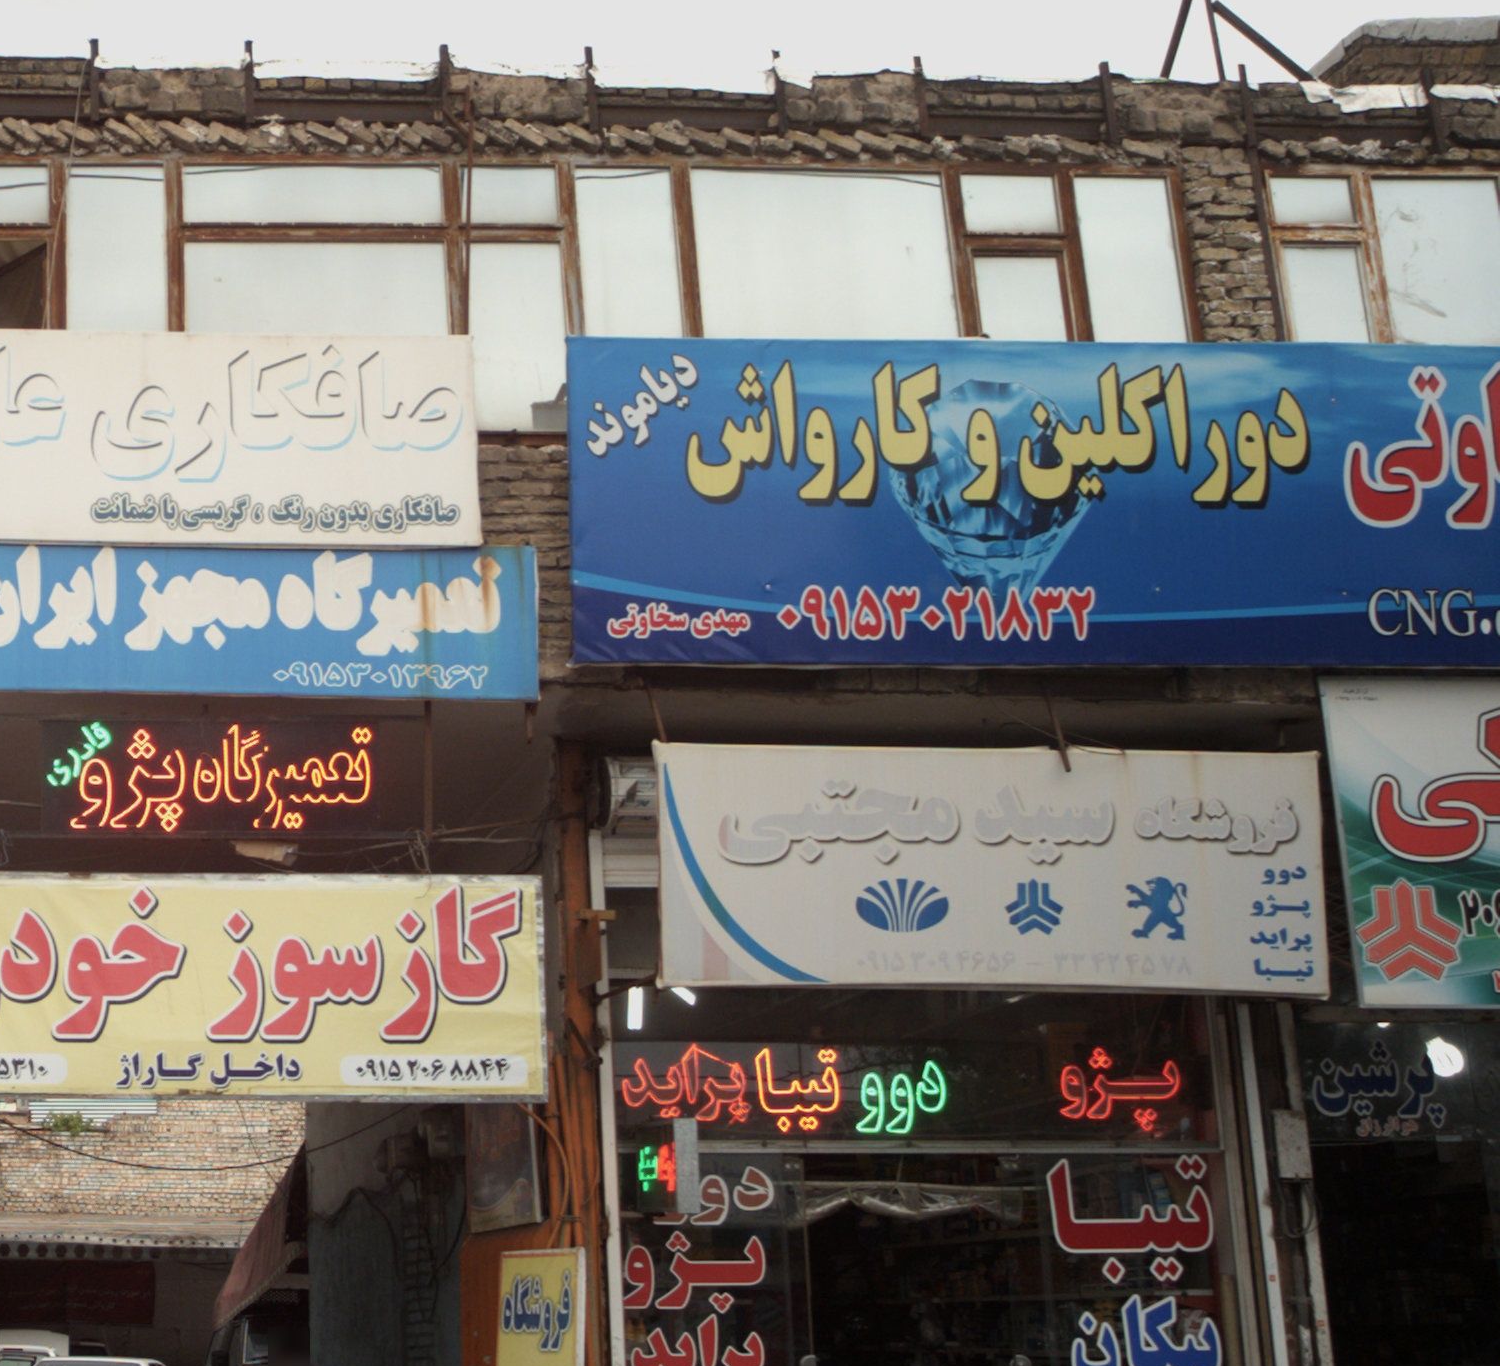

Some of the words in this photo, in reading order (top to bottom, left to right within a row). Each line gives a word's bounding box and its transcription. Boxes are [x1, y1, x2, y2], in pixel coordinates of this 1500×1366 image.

[90, 344, 464, 483] صافکاری
[585, 349, 701, 458] دیاموند
[686, 359, 941, 508] کارواش
[960, 406, 1002, 505] و
[90, 491, 160, 526] ضمانت
[160, 492, 179, 530] با
[269, 494, 318, 532] رنگ
[317, 498, 371, 532] بدون
[371, 495, 460, 532] صافکاری
[124, 557, 271, 652] مجهز
[276, 549, 503, 655] تعمیرگاه
[606, 601, 690, 639] سخاوتی
[690, 608, 751, 639] مهدی
[775, 583, 1096, 644] ۰۹۱۵۳۰۲۱۸۳۲
[69, 728, 187, 833] پژو
[717, 778, 961, 868] مجتبی
[974, 782, 1117, 866] سید
[1132, 796, 1301, 856] فروشگاه
[1261, 865, 1307, 885] دوو
[1249, 894, 1312, 919] پژو
[1249, 927, 1314, 953] پراید
[1253, 957, 1314, 982] تیبا
[115, 1051, 205, 1089] گاراژ
[209, 1052, 302, 1088] داخل
[754, 1047, 841, 1133] تیبا
[855, 1059, 947, 1134] دوو
[1058, 1046, 1183, 1131] پژو
[1046, 1153, 1215, 1285] تیبا
[622, 1229, 767, 1311] پژو
[501, 1270, 573, 1352] فروشگاه
